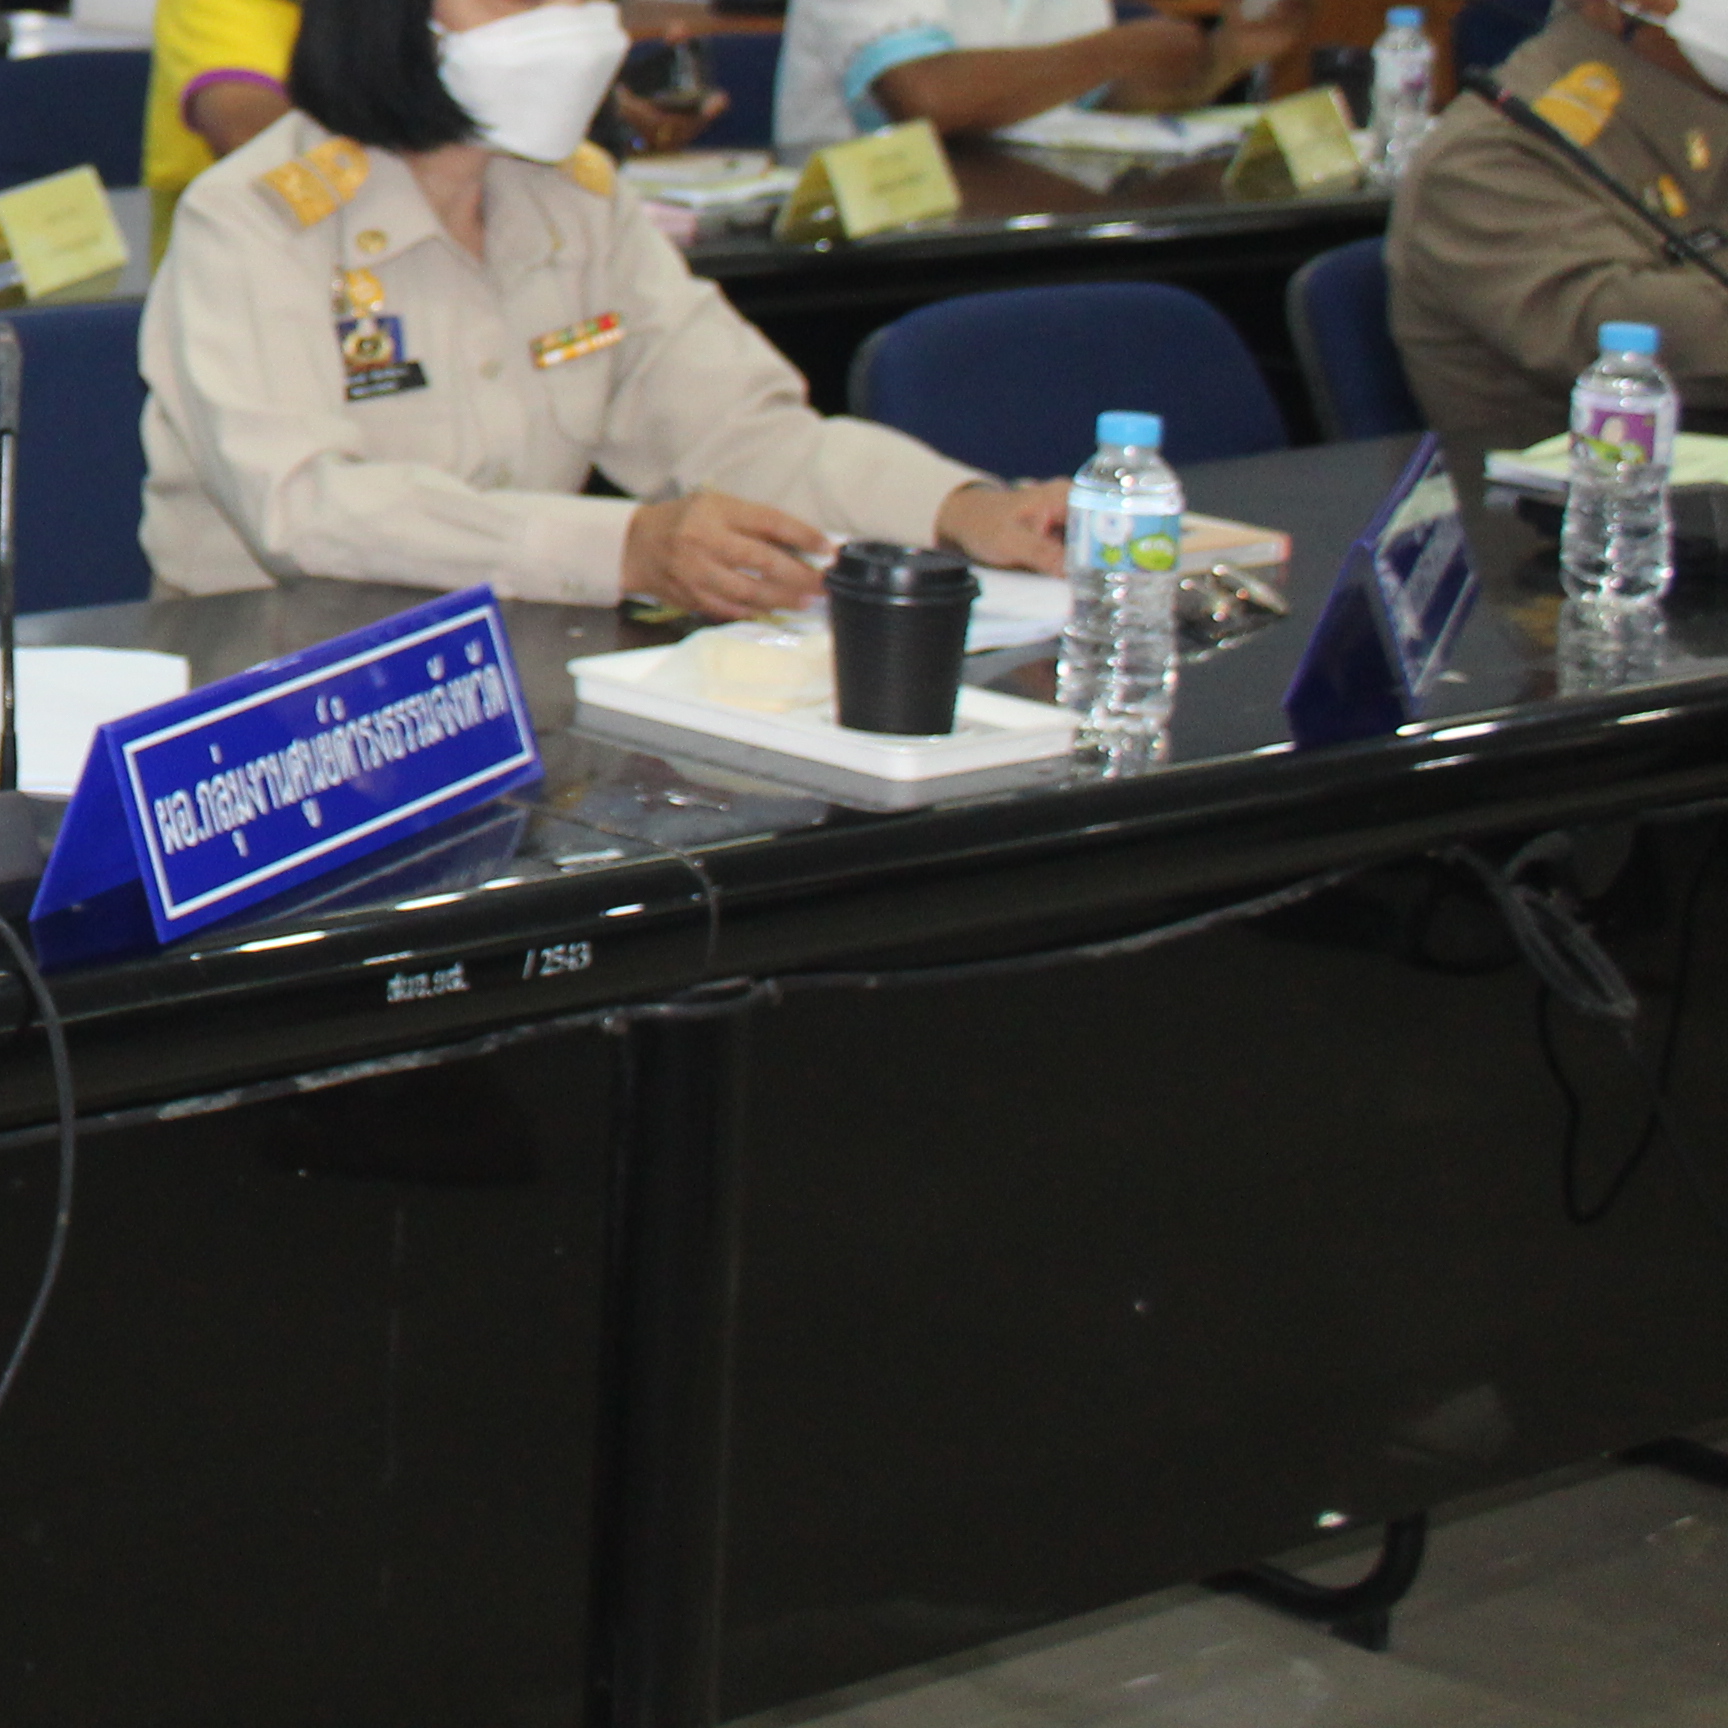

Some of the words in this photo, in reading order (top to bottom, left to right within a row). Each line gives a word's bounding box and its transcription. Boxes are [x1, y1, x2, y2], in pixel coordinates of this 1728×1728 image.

[155, 639, 507, 858] ผอ.กลุ่มงานศูนย์ดำรงธรรมจังหวัด
